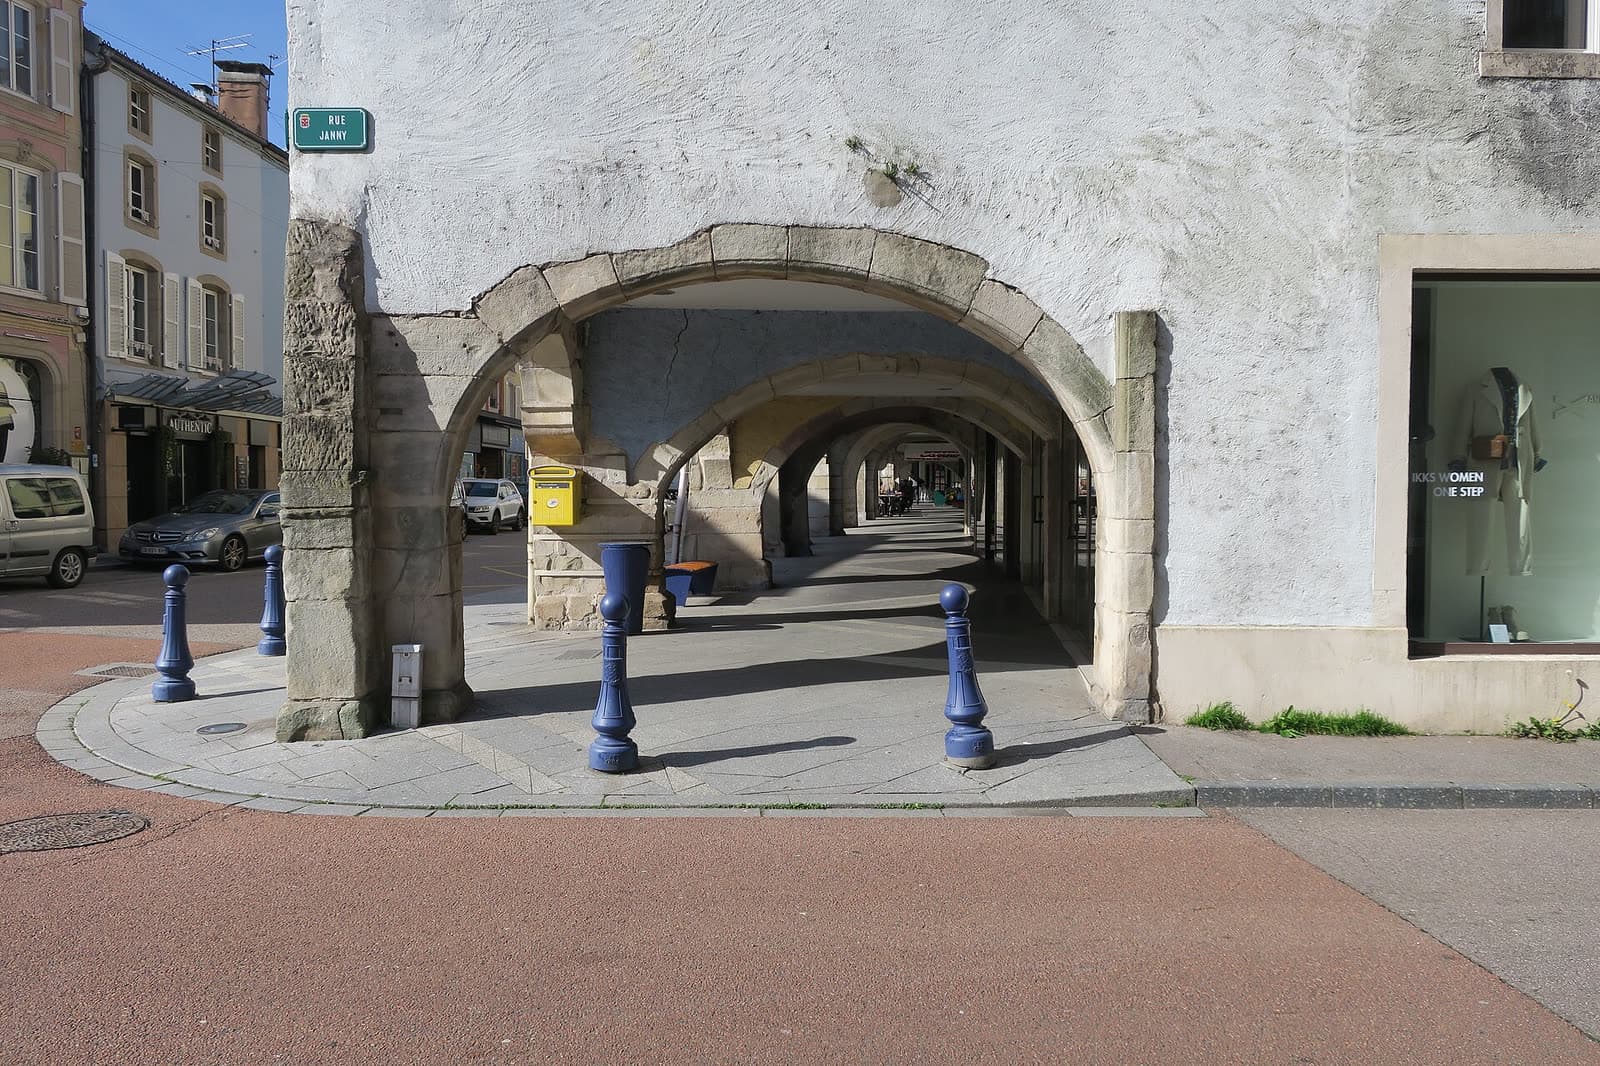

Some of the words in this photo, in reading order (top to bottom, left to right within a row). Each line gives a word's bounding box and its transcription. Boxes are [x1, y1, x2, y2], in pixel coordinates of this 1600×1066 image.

[328, 115, 346, 125] RUE
[319, 130, 347, 141] JANNY
[170, 418, 212, 434] AUTHENTIC
[1412, 472, 1436, 482] IKKS
[1439, 472, 1484, 482] WOMEN
[1433, 486, 1458, 497] ONE
[1460, 486, 1484, 497] STEP
